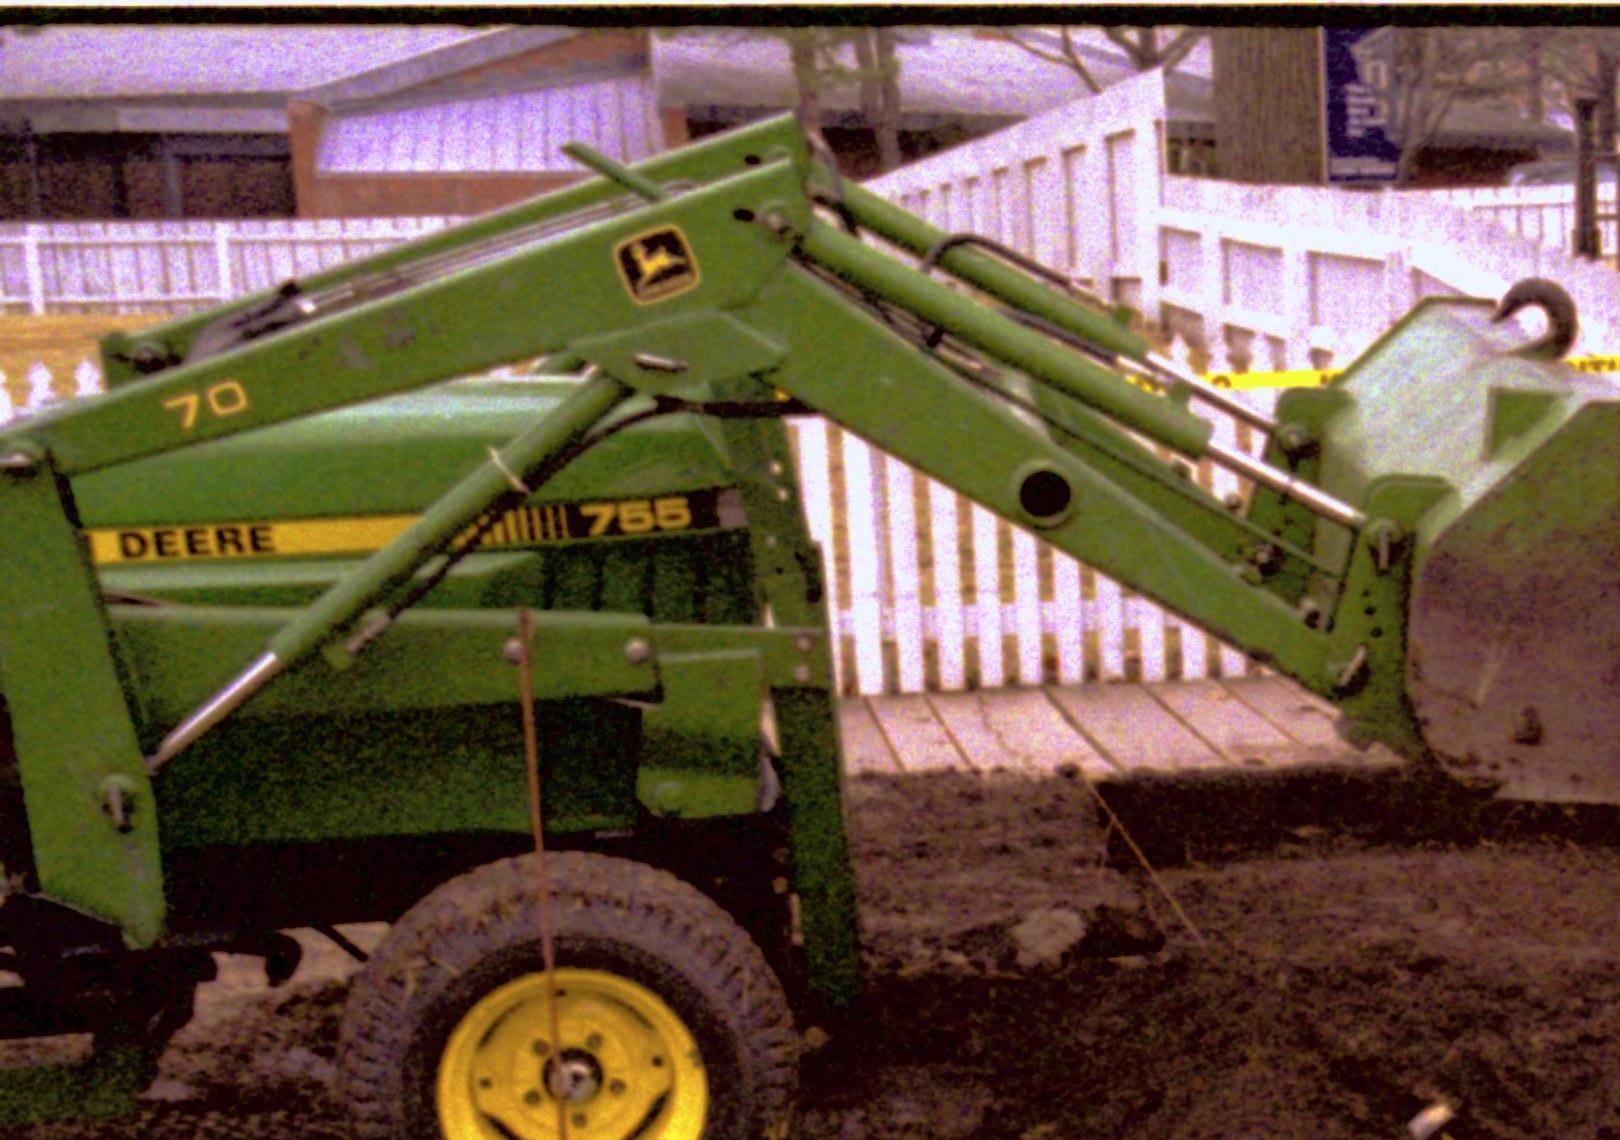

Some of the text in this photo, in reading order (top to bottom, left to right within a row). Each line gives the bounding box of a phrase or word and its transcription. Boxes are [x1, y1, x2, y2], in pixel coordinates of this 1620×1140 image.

[162, 381, 249, 430] 70
[580, 497, 692, 537] 755
[118, 526, 277, 560] DEERE
